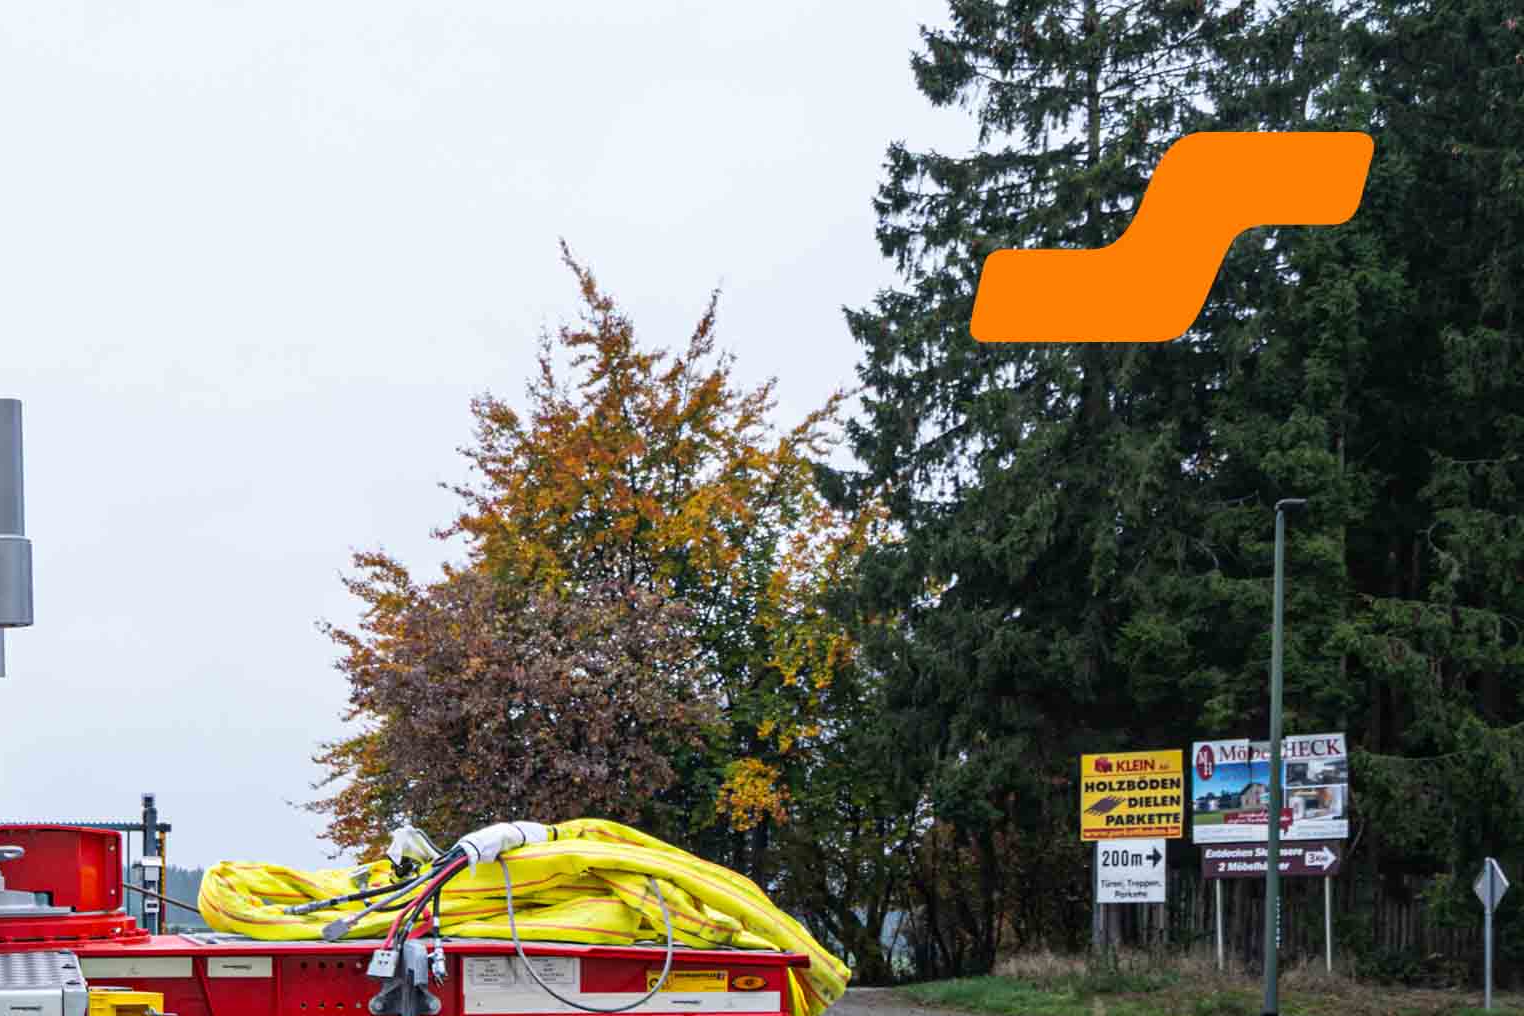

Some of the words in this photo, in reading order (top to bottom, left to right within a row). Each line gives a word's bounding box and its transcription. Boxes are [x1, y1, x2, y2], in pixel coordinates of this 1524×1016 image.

[1282, 738, 1340, 758] HECK
[1116, 759, 1155, 772] KLEIN
[1084, 776, 1181, 793] HOLZBÖDEN
[1127, 795, 1181, 809] DIELEN
[1104, 811, 1181, 826] PARKETTE
[1217, 862, 1226, 872] 2
